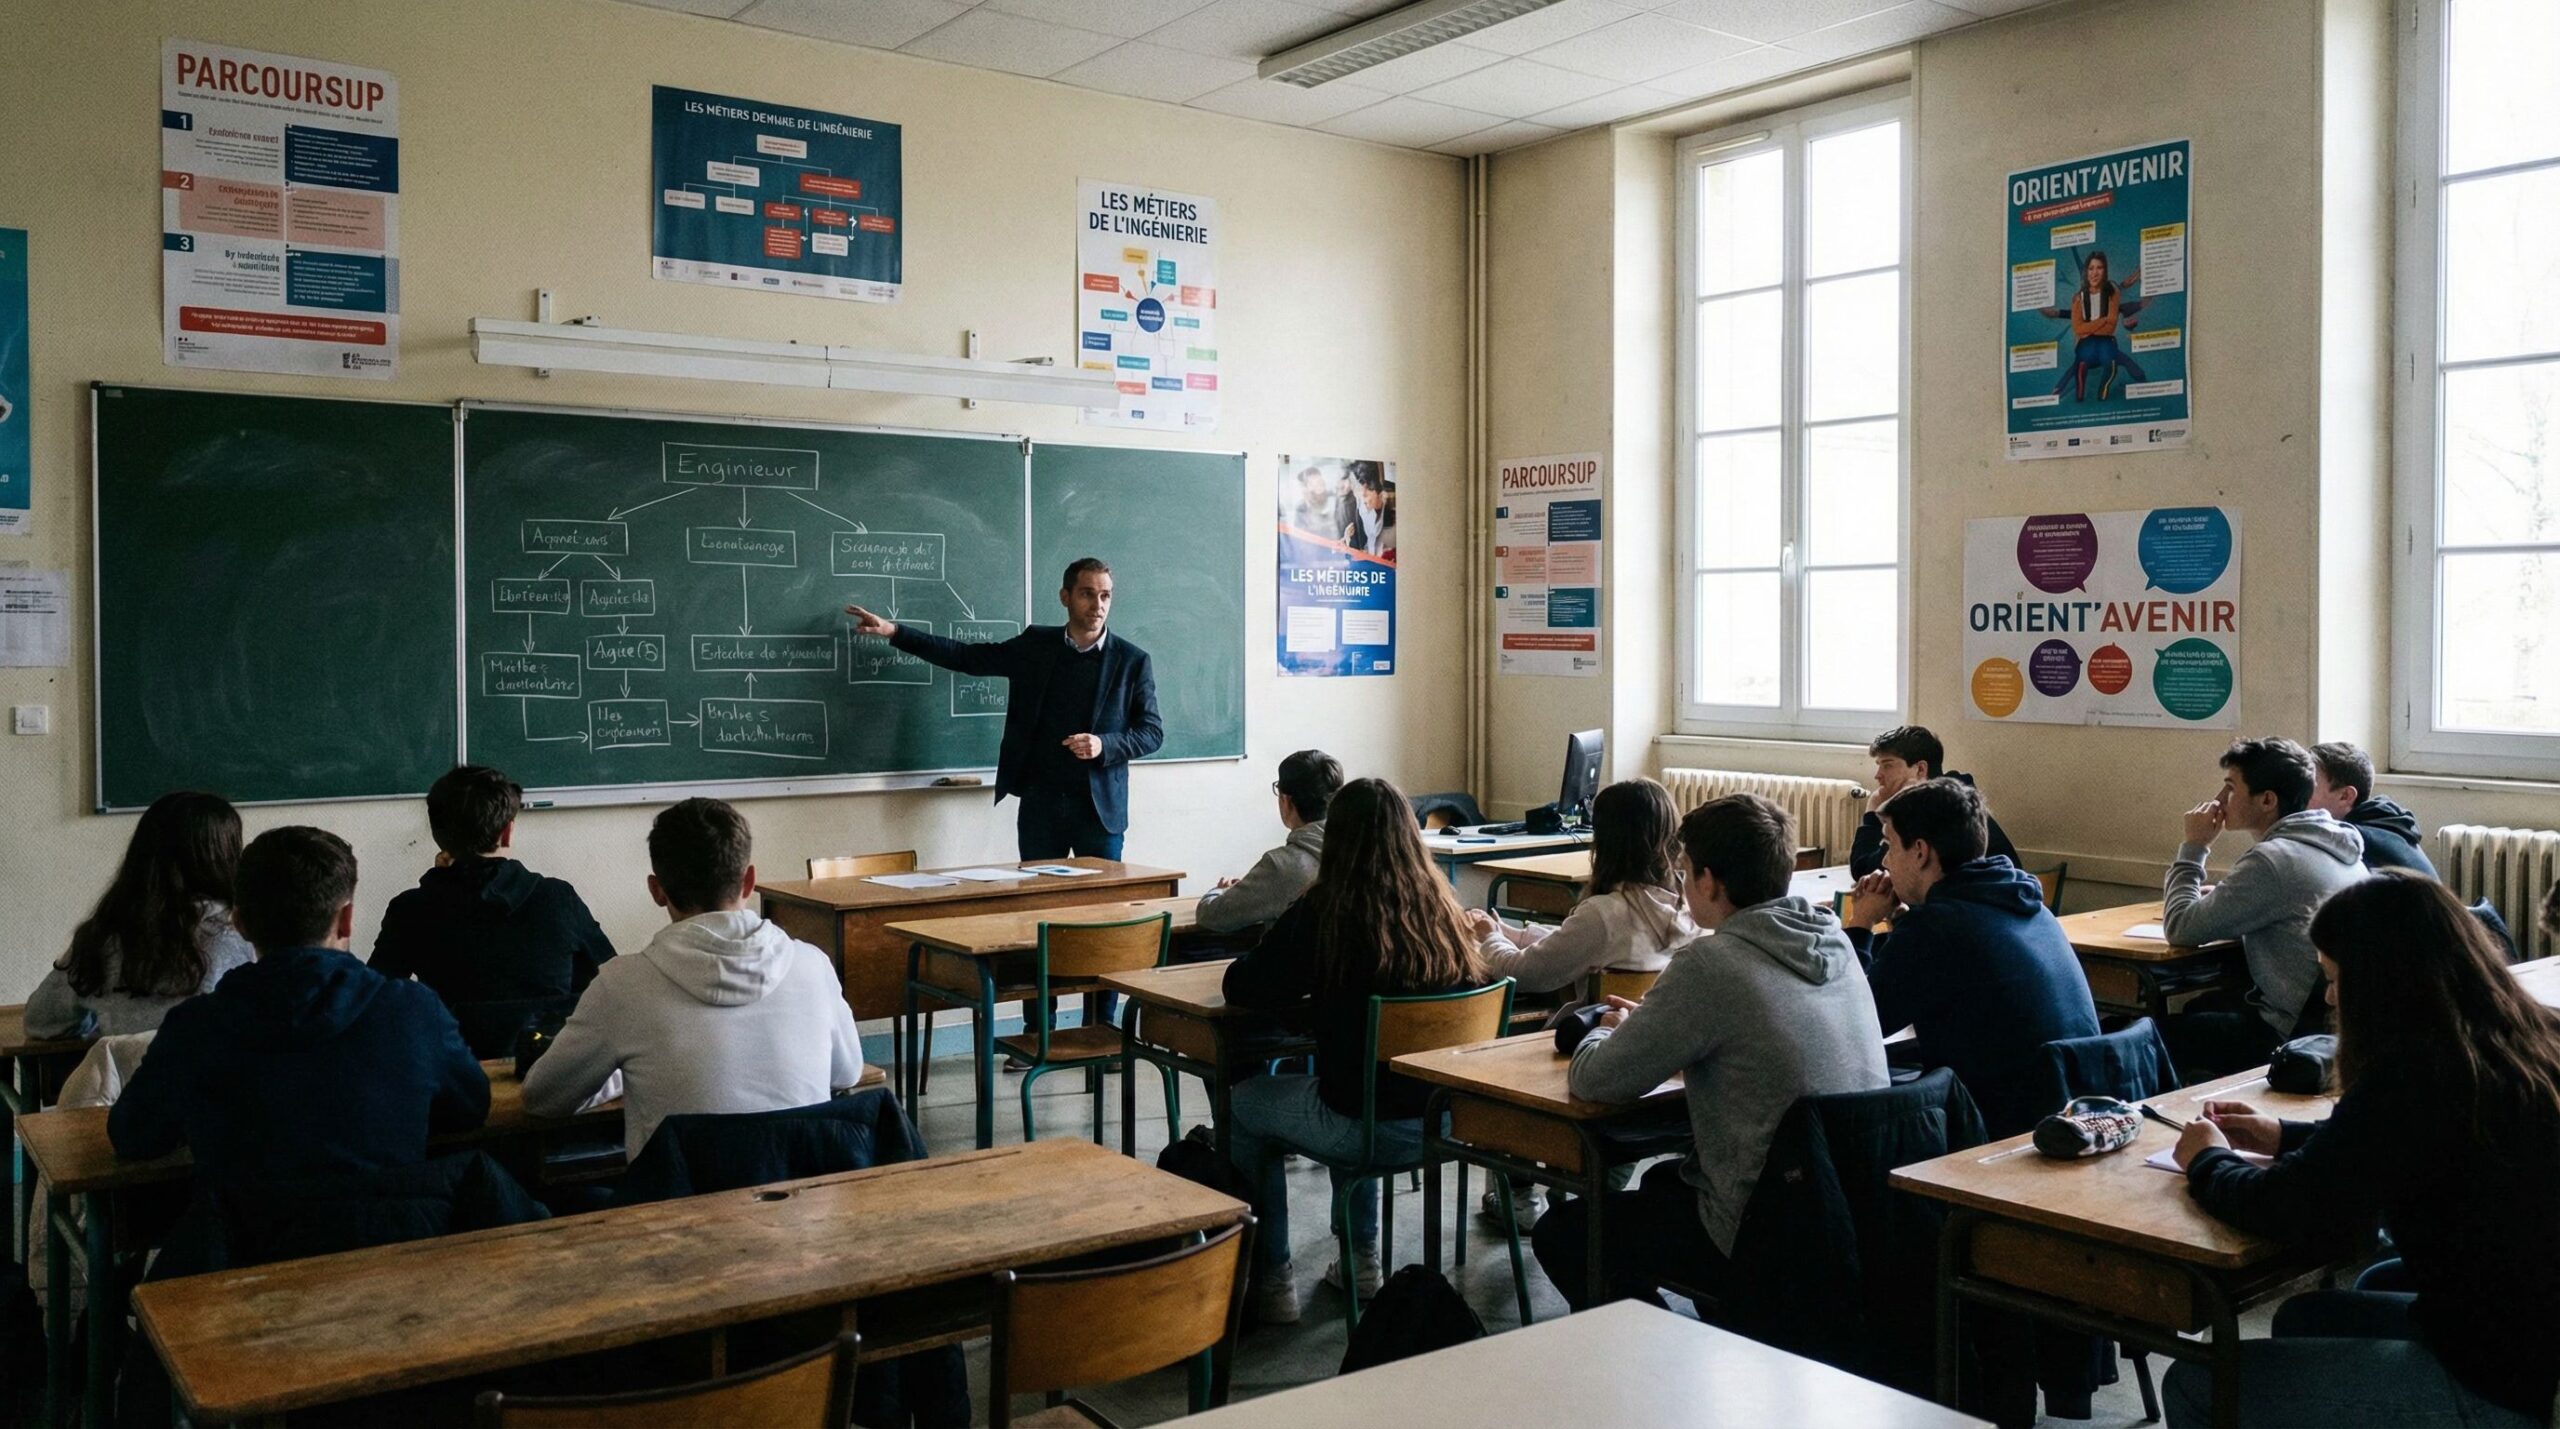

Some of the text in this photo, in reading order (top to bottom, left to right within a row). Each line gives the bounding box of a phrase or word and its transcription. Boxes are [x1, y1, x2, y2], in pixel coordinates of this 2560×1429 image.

[177, 53, 384, 112] PARCOURSUP
[180, 115, 188, 129] 1
[685, 101, 704, 114] LES
[797, 119, 811, 130] DE
[179, 175, 190, 189] 2
[2012, 150, 2184, 206] ORIENT'AVENIR
[1101, 190, 1197, 221] LES MÉTIERS
[1089, 212, 1207, 244] DE L'INGÉNIERIE
[179, 236, 190, 250] 3
[1502, 461, 1597, 489] PARCOURSUP
[1290, 566, 1386, 584] LES MÉTIERS DE
[1970, 601, 2236, 633] ORIENT'AVENIR
